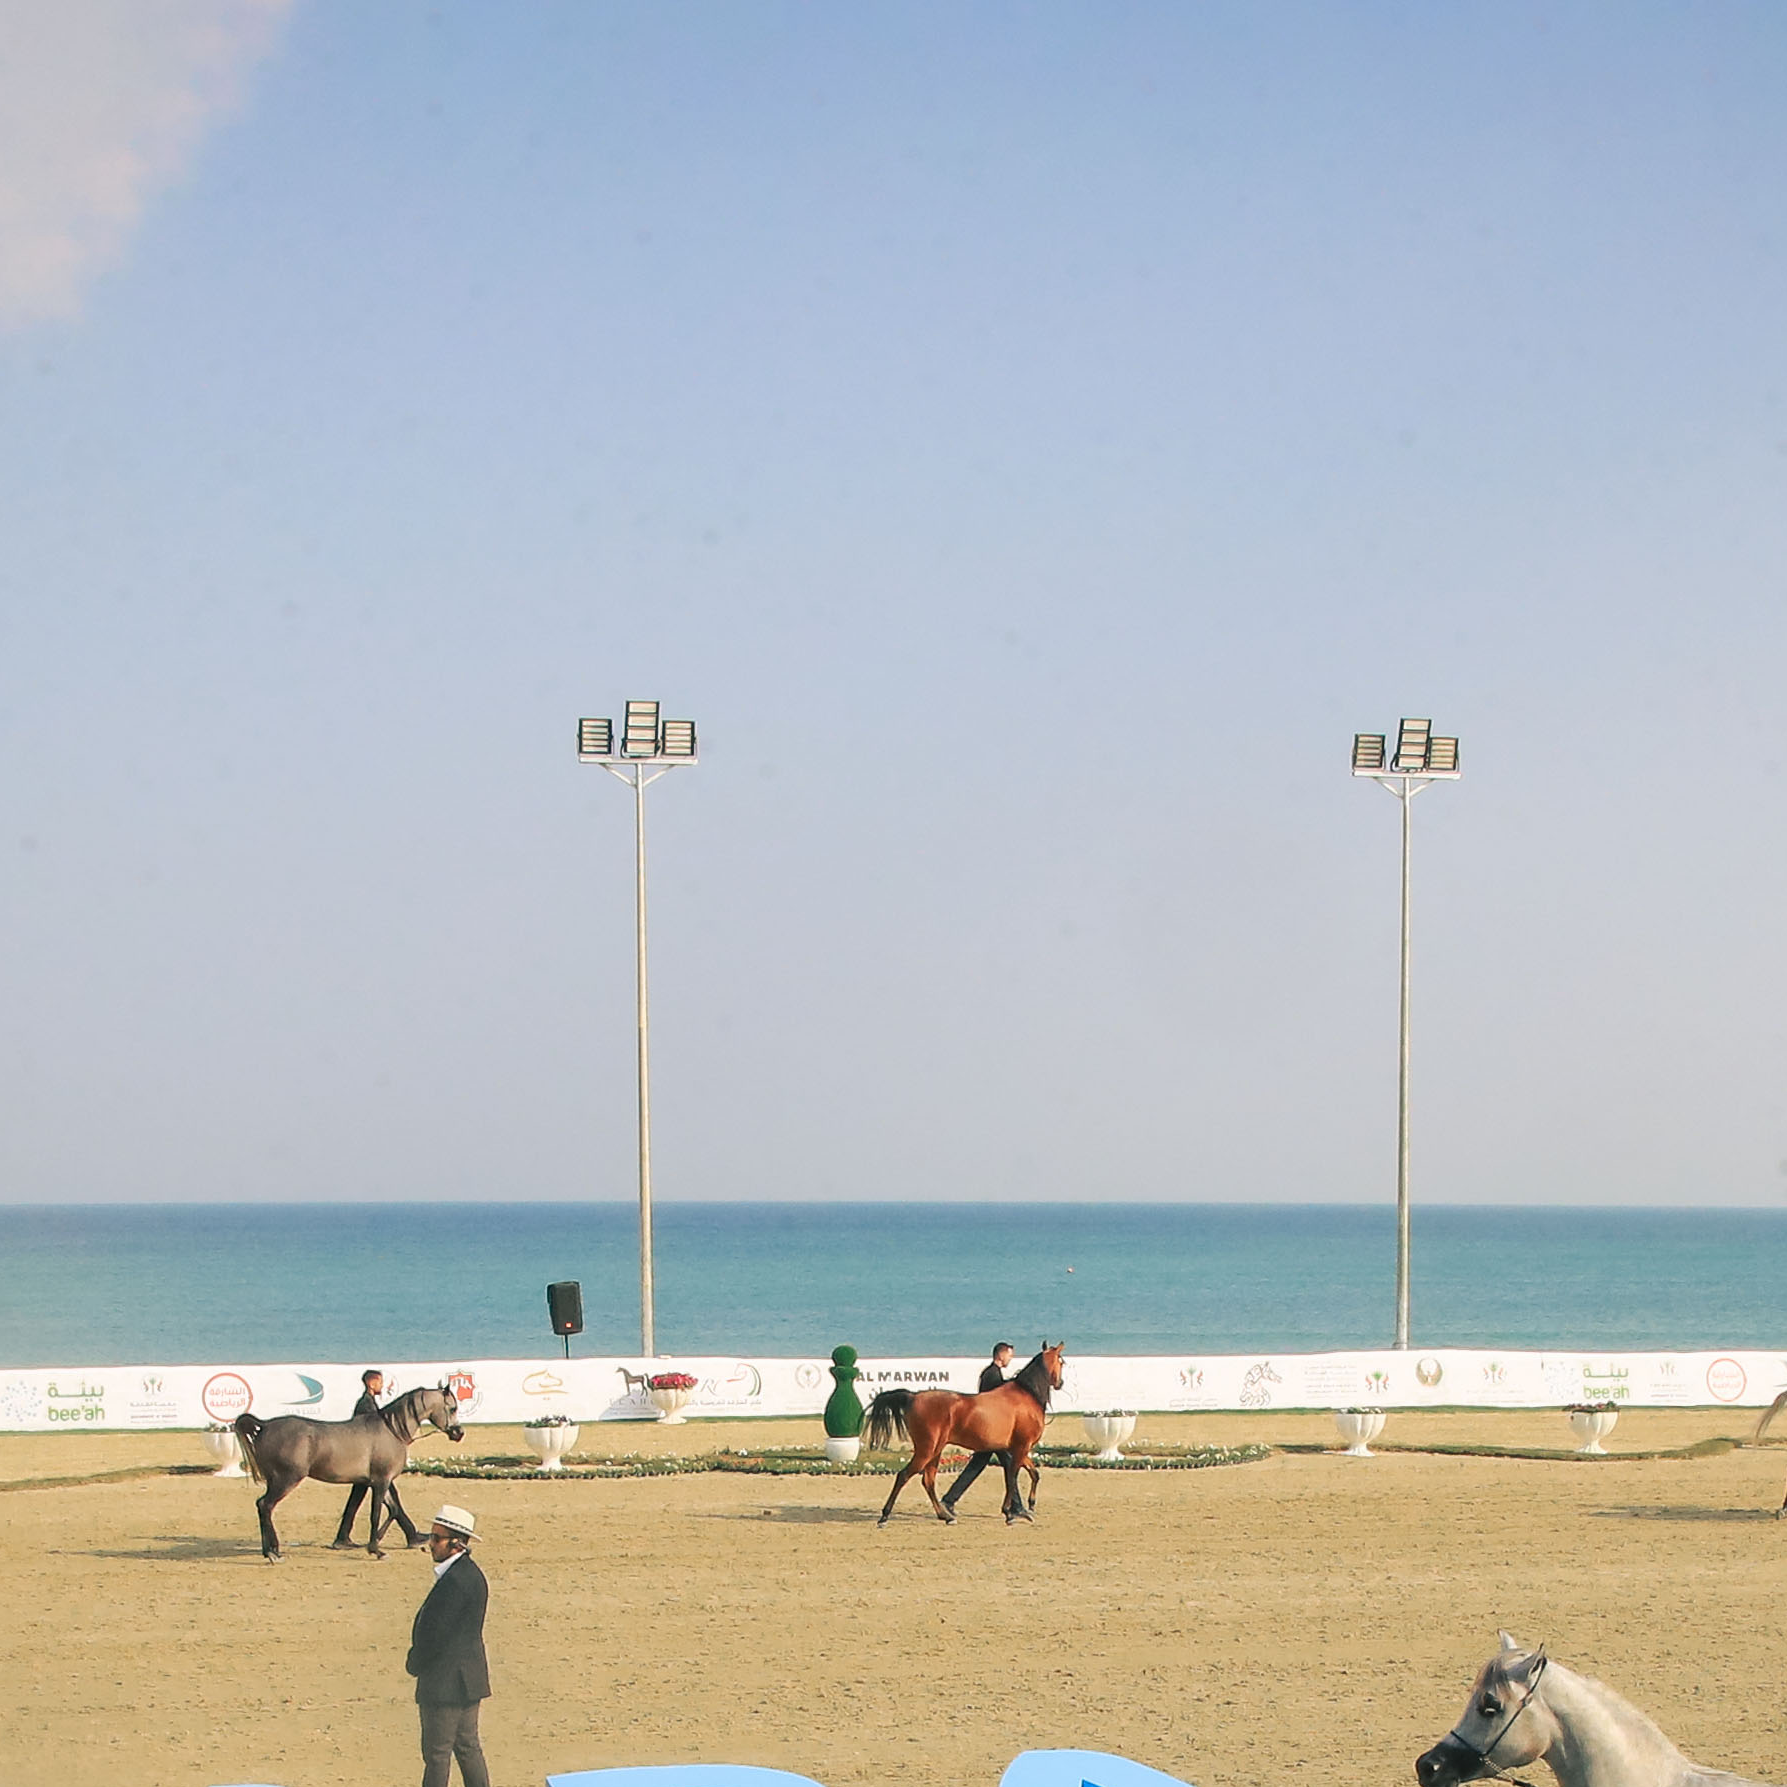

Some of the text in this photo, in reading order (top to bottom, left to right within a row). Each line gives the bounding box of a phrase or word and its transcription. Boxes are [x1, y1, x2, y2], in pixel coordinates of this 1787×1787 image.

[856, 1370, 950, 1382] AL MARWAN
[1582, 1384, 1630, 1400] bee'ah
[47, 1403, 106, 1422] bee'ah
